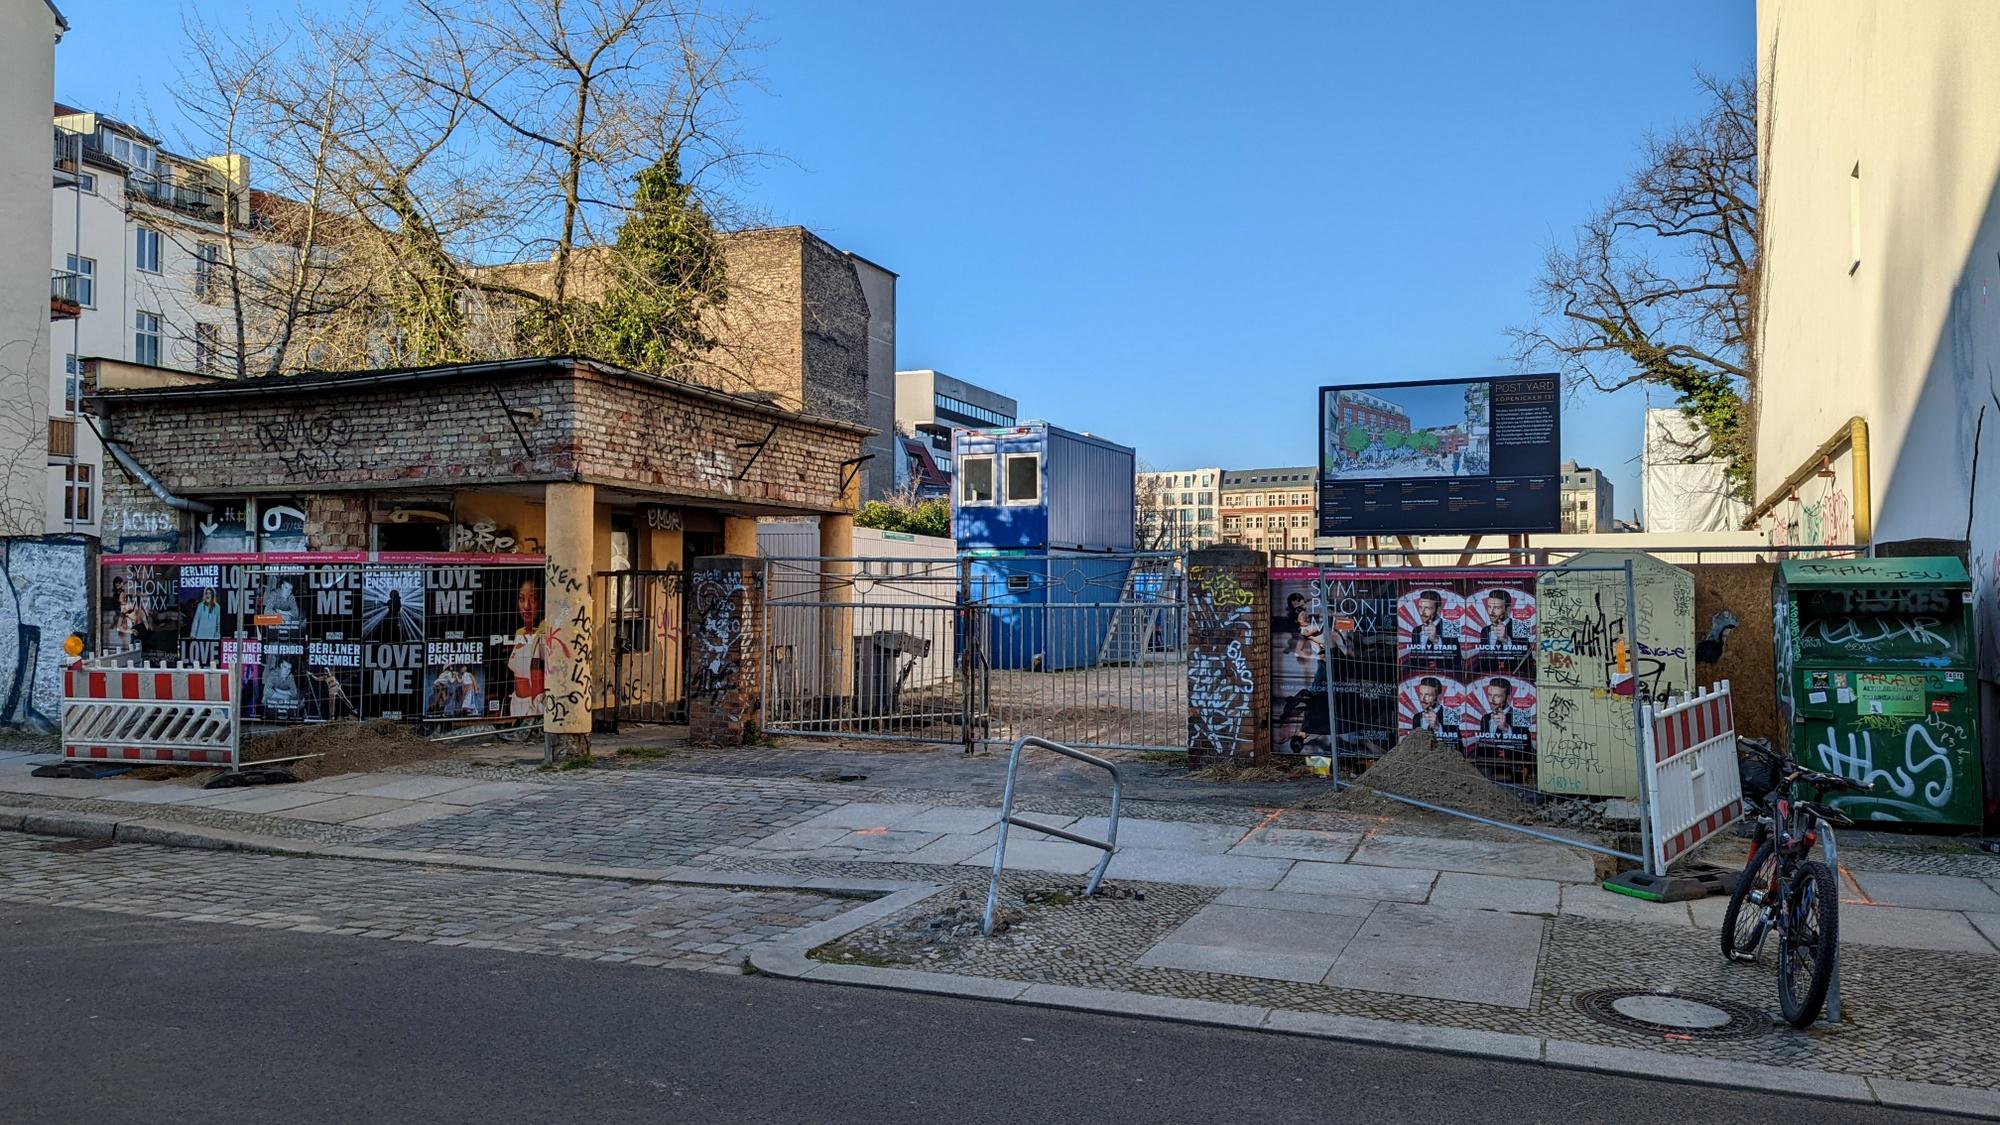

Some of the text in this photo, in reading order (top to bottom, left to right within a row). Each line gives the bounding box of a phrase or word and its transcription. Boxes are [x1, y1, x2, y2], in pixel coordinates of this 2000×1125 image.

[1495, 381, 1554, 393] POST YARD
[126, 565, 161, 579] SYM-
[180, 565, 219, 577] BERLINER
[222, 565, 261, 588] LOVE
[309, 565, 361, 589] LOVE
[426, 565, 482, 589] LOVE
[127, 580, 179, 596] PHONIE
[180, 576, 219, 588] ENSEMBLE
[365, 577, 422, 589] ENSEMBLE
[1310, 579, 1368, 597] SYM-
[126, 596, 167, 610] MMXX
[227, 590, 255, 614] ME
[317, 590, 353, 615] ME
[435, 590, 474, 614] ME
[1311, 597, 1397, 616] PHONIE
[181, 641, 220, 665] LOVE
[222, 641, 262, 653] BERINER
[263, 644, 304, 655] SAM FENDER
[308, 642, 361, 655] BERLINER
[428, 642, 484, 654] BERLINER
[1475, 643, 1501, 651] LUCKY
[222, 653, 262, 665] ENSMBLE
[308, 654, 361, 667] ENSEMBLE
[365, 644, 423, 668] LOVE
[427, 653, 484, 665] ENSEMBLE
[373, 670, 413, 694] ME
[1475, 731, 1528, 740] LUCKY STARS
